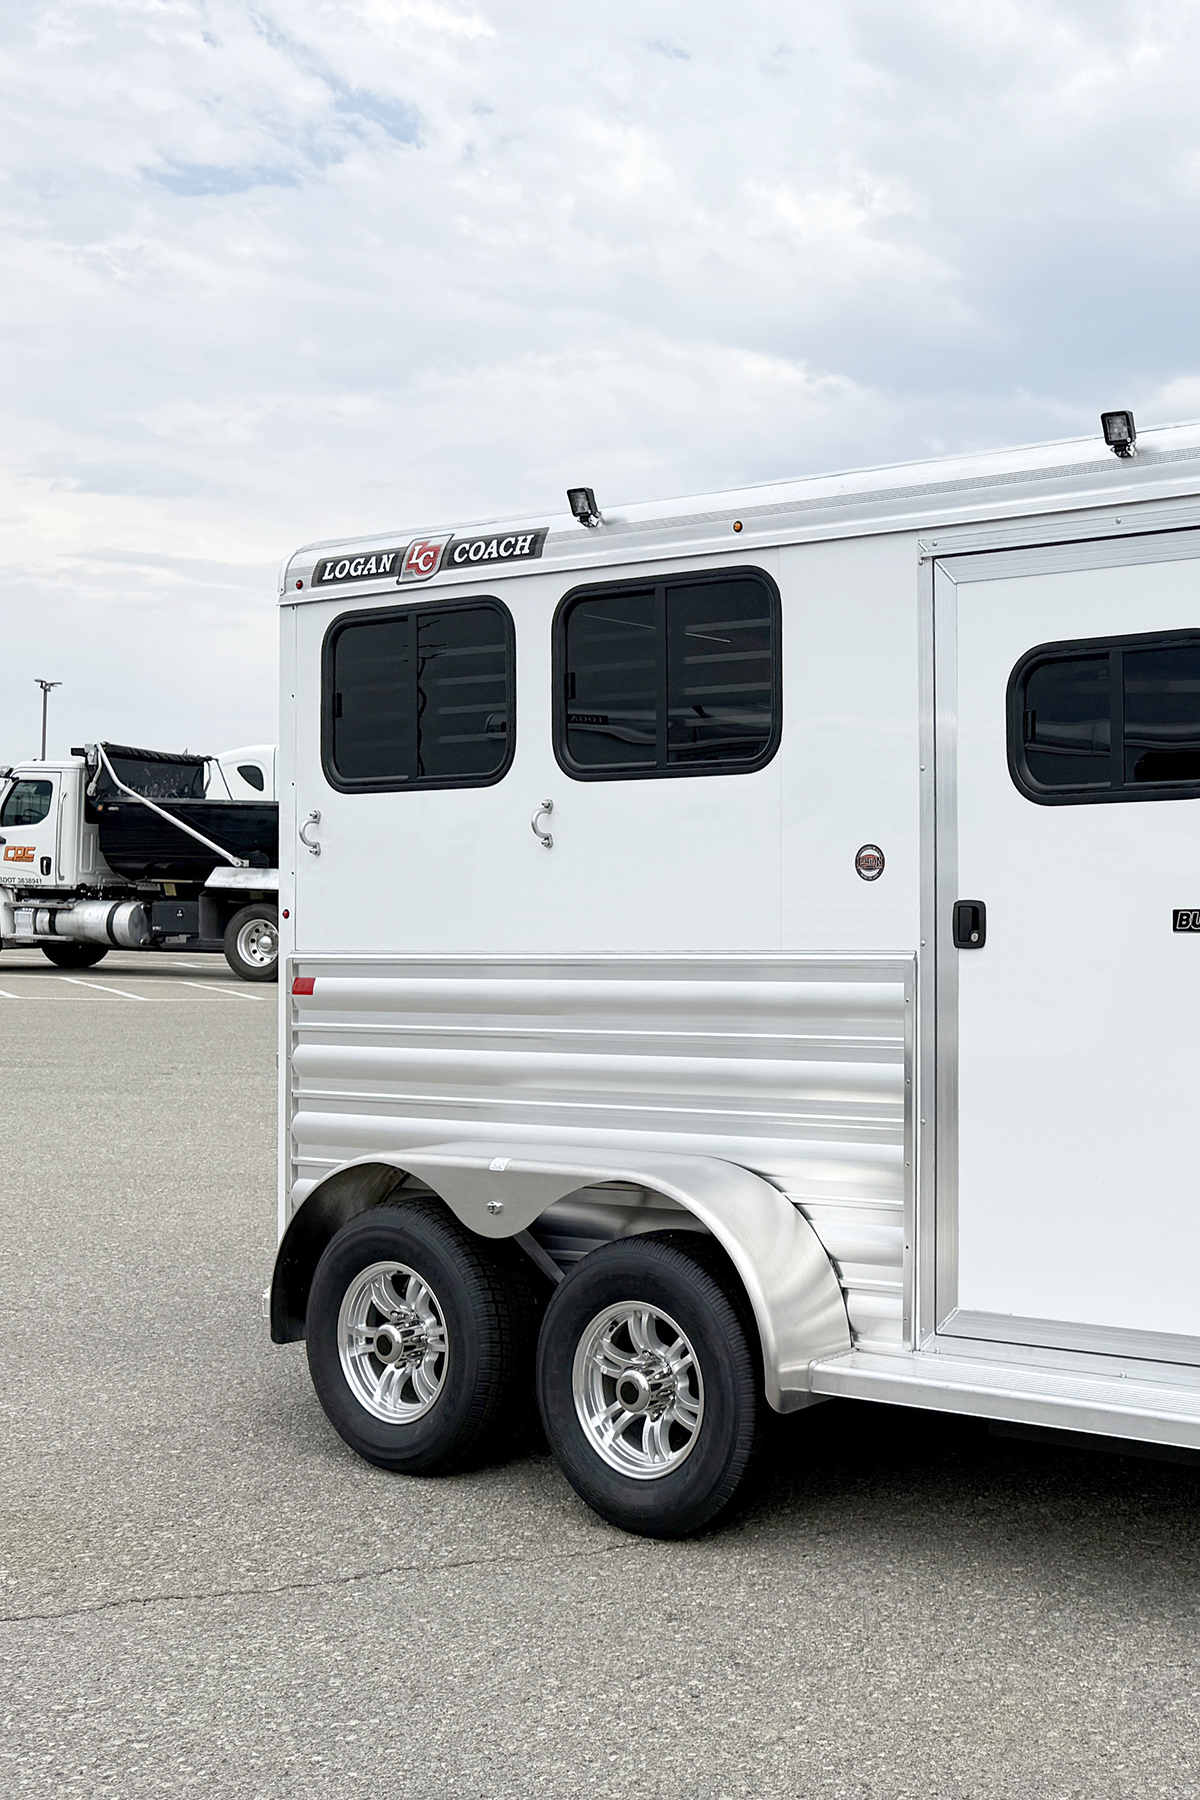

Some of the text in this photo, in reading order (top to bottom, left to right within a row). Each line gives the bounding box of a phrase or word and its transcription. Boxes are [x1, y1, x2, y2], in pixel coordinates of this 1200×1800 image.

[322, 534, 535, 580] LOGAN LC COACH
